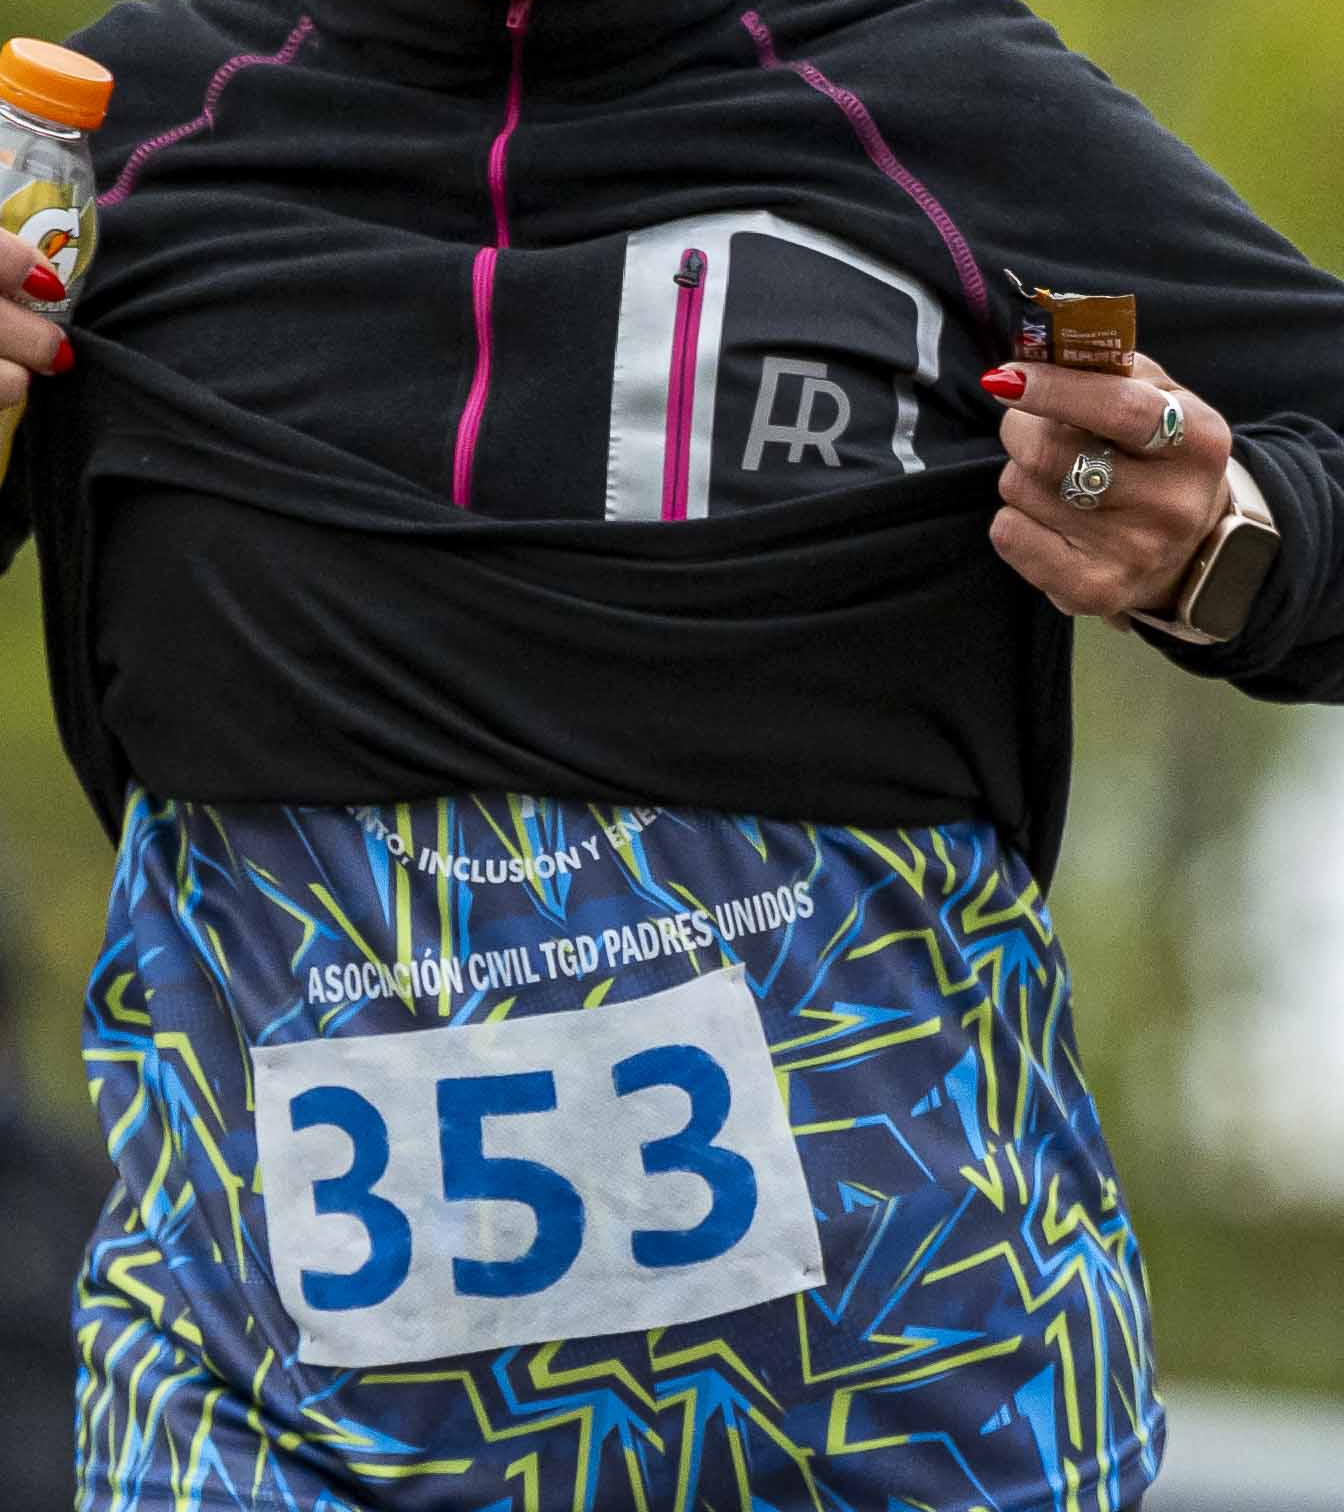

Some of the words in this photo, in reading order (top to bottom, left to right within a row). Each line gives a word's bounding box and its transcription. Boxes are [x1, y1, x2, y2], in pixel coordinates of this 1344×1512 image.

[418, 845, 582, 884] INCLUSIÓN
[581, 835, 601, 861] Y
[308, 947, 464, 1004] ASOCIACIÓN
[468, 946, 540, 992] CIVIL
[539, 934, 599, 980] TGD
[602, 909, 714, 968] PADRES
[714, 881, 814, 942] UNIDOS
[289, 1044, 758, 1313] 353
